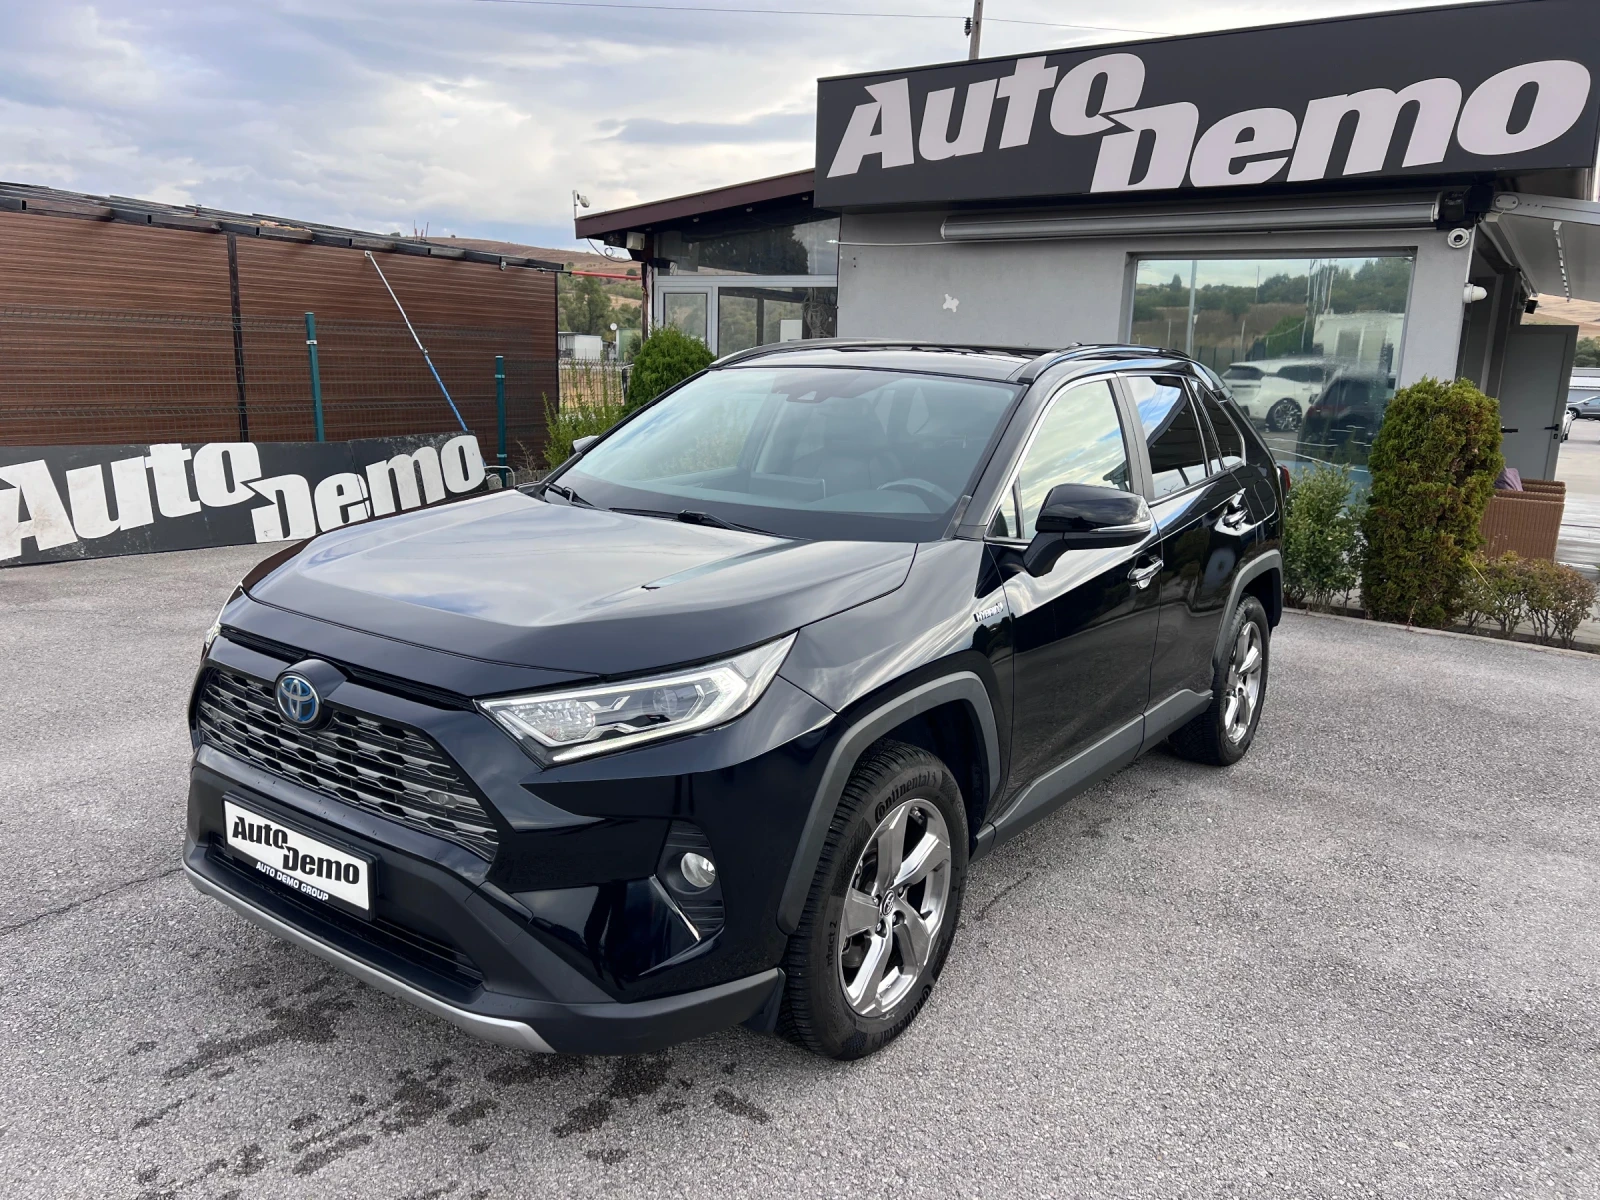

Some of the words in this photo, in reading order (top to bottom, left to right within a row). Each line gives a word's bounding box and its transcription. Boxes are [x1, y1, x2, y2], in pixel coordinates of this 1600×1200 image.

[827, 53, 1145, 178] Auto
[1091, 59, 1591, 193] Demo
[0, 443, 261, 561] Auto
[247, 435, 485, 543] Demo
[875, 771, 930, 823] Continental
[232, 816, 288, 849] Auto
[282, 845, 360, 885] Demo
[256, 862, 275, 876] AUTO
[277, 872, 299, 889] DEMO
[301, 883, 329, 901] GROUP
